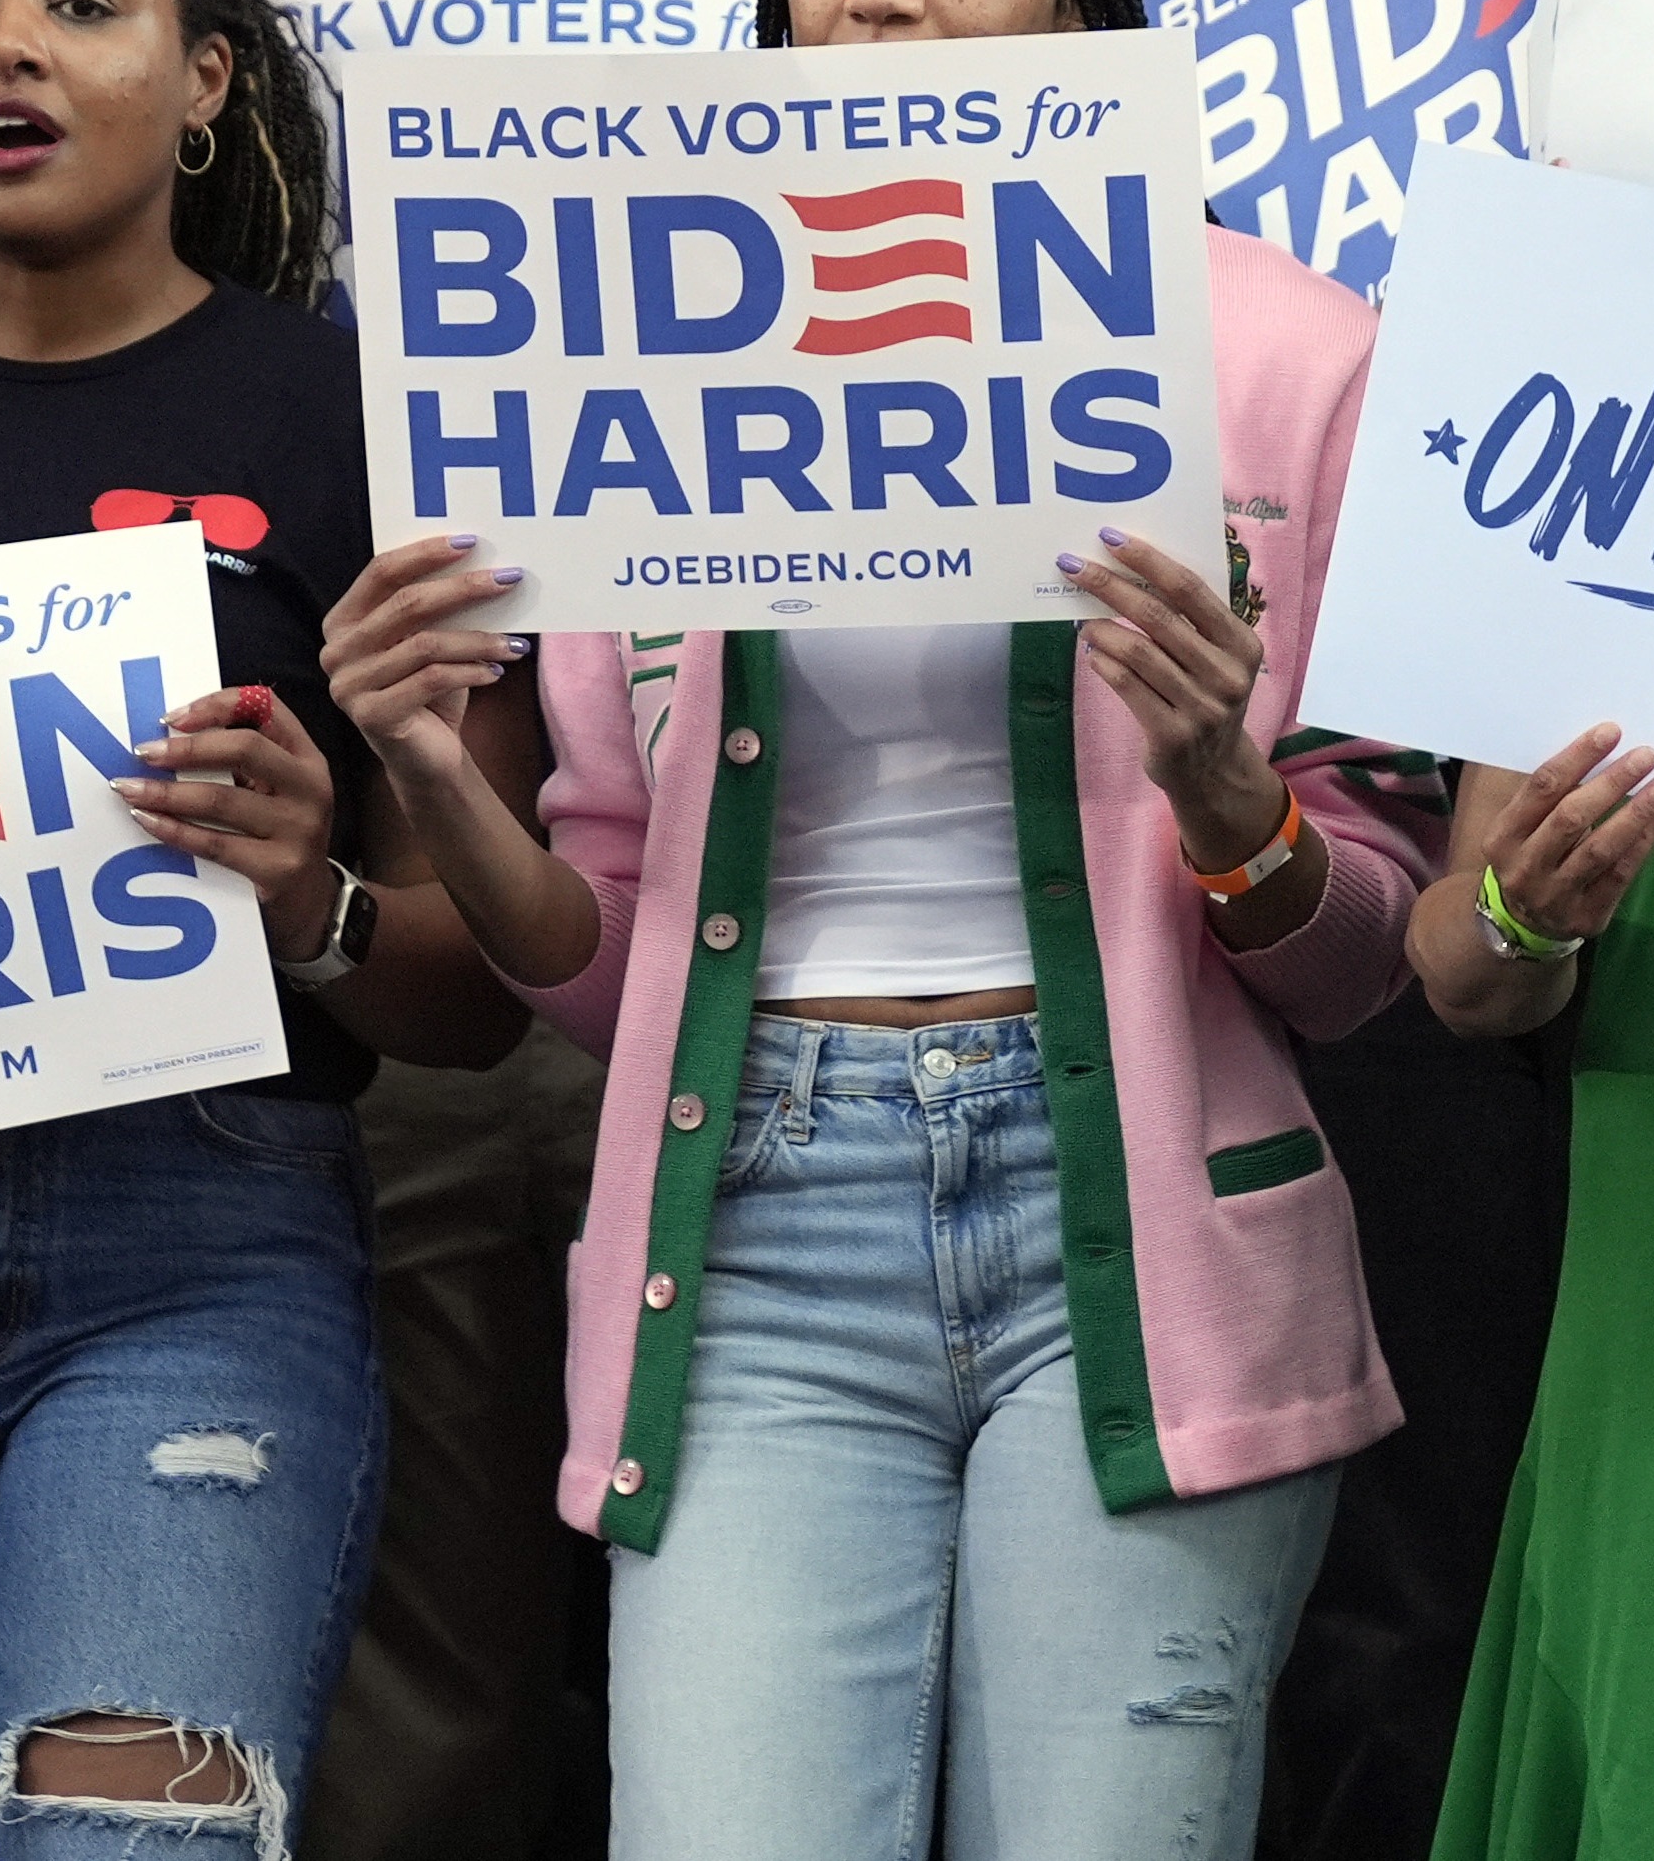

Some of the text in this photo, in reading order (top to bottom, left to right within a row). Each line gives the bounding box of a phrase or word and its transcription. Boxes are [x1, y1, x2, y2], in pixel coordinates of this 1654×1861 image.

[388, 85, 1120, 159] BLACK VOTERS for
[394, 173, 1156, 358] BIDEN
[407, 368, 1173, 519] HARRIS
[205, 551, 258, 576] ARRIS
[613, 547, 973, 588] JOEBIDEN.COM
[28, 584, 132, 654] for
